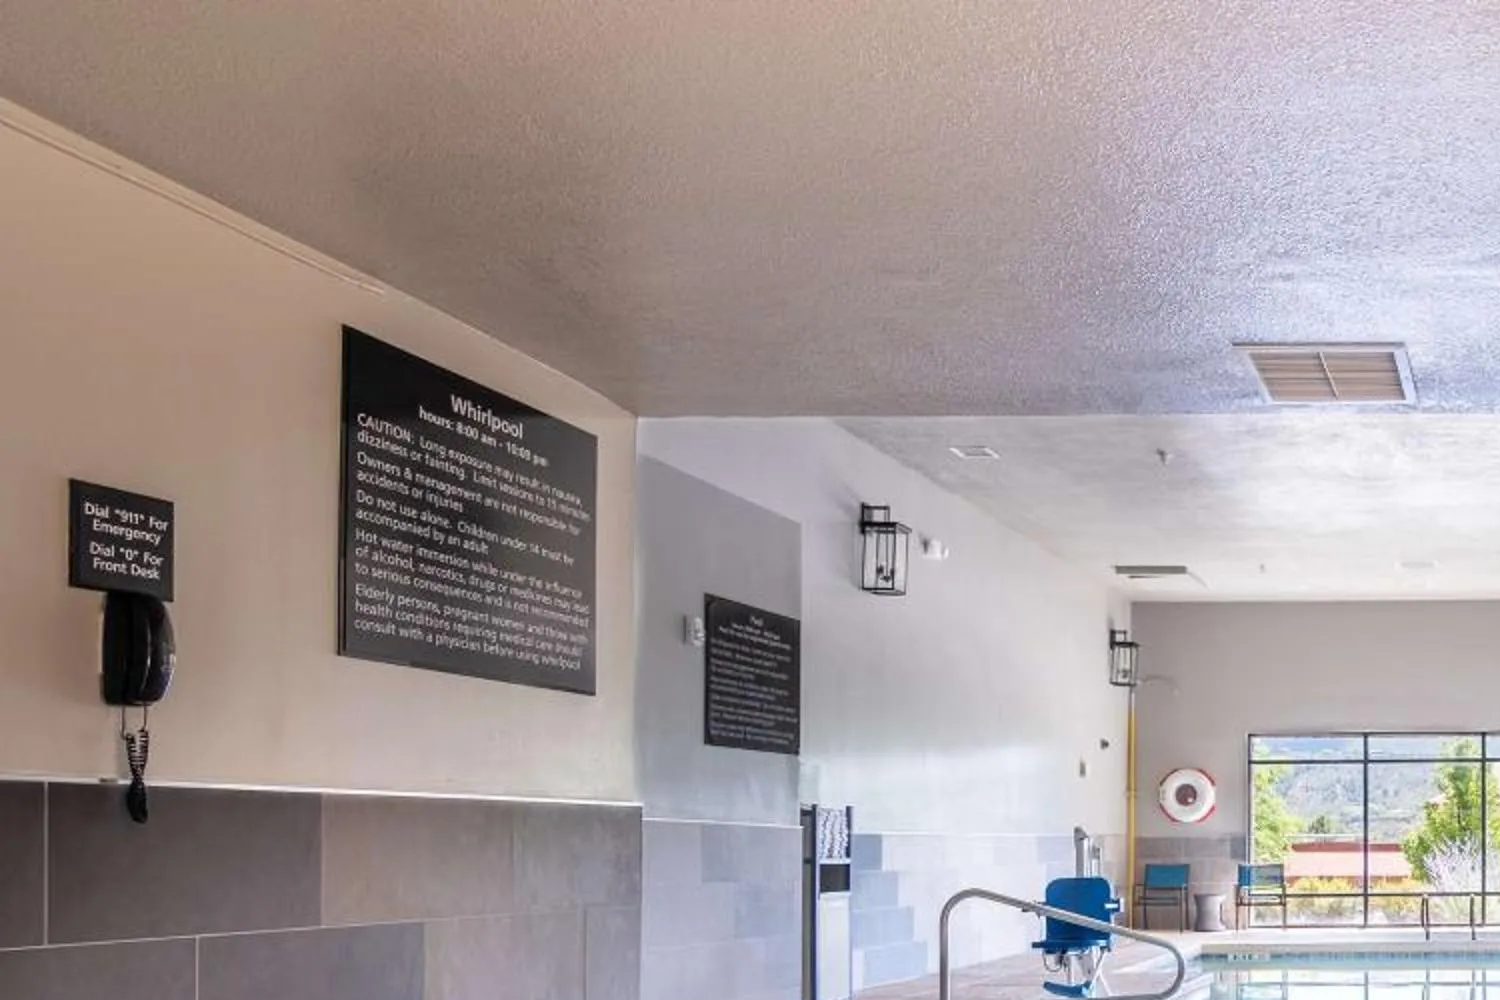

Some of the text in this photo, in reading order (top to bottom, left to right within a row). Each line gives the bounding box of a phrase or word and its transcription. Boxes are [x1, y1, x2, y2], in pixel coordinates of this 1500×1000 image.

[419, 405, 454, 430] hours:
[455, 420, 479, 440] 8:00
[480, 433, 497, 447] am
[450, 394, 523, 439] Whirlpool
[357, 413, 415, 444] CAUTION:
[420, 436, 447, 459] Long
[448, 449, 493, 472] exposure
[357, 429, 409, 457] dizziness
[410, 451, 422, 461] or
[357, 452, 401, 477] Owners
[403, 467, 413, 481] &
[415, 473, 482, 502] management
[357, 470, 410, 495] accidents
[411, 488, 423, 499] or
[83, 501, 109, 518] Dial
[149, 516, 168, 532] For
[92, 518, 161, 546] Emergency
[356, 489, 375, 505] Do
[377, 498, 397, 513] not
[400, 504, 419, 519] use
[457, 520, 499, 543] Children
[356, 509, 431, 539] accompanied
[432, 528, 446, 546] by
[447, 535, 461, 547] an
[89, 541, 115, 558] Dial
[143, 551, 164, 566] For
[355, 527, 377, 544] Hot
[416, 545, 470, 569] immersion
[355, 545, 370, 557] of
[93, 557, 160, 579] Front Desk
[355, 562, 369, 576] to
[371, 567, 411, 585] serious
[355, 583, 395, 605] Elderly
[397, 594, 442, 615] persons,
[355, 598, 393, 619] health
[395, 611, 450, 631] conditions
[354, 619, 397, 637] consult
